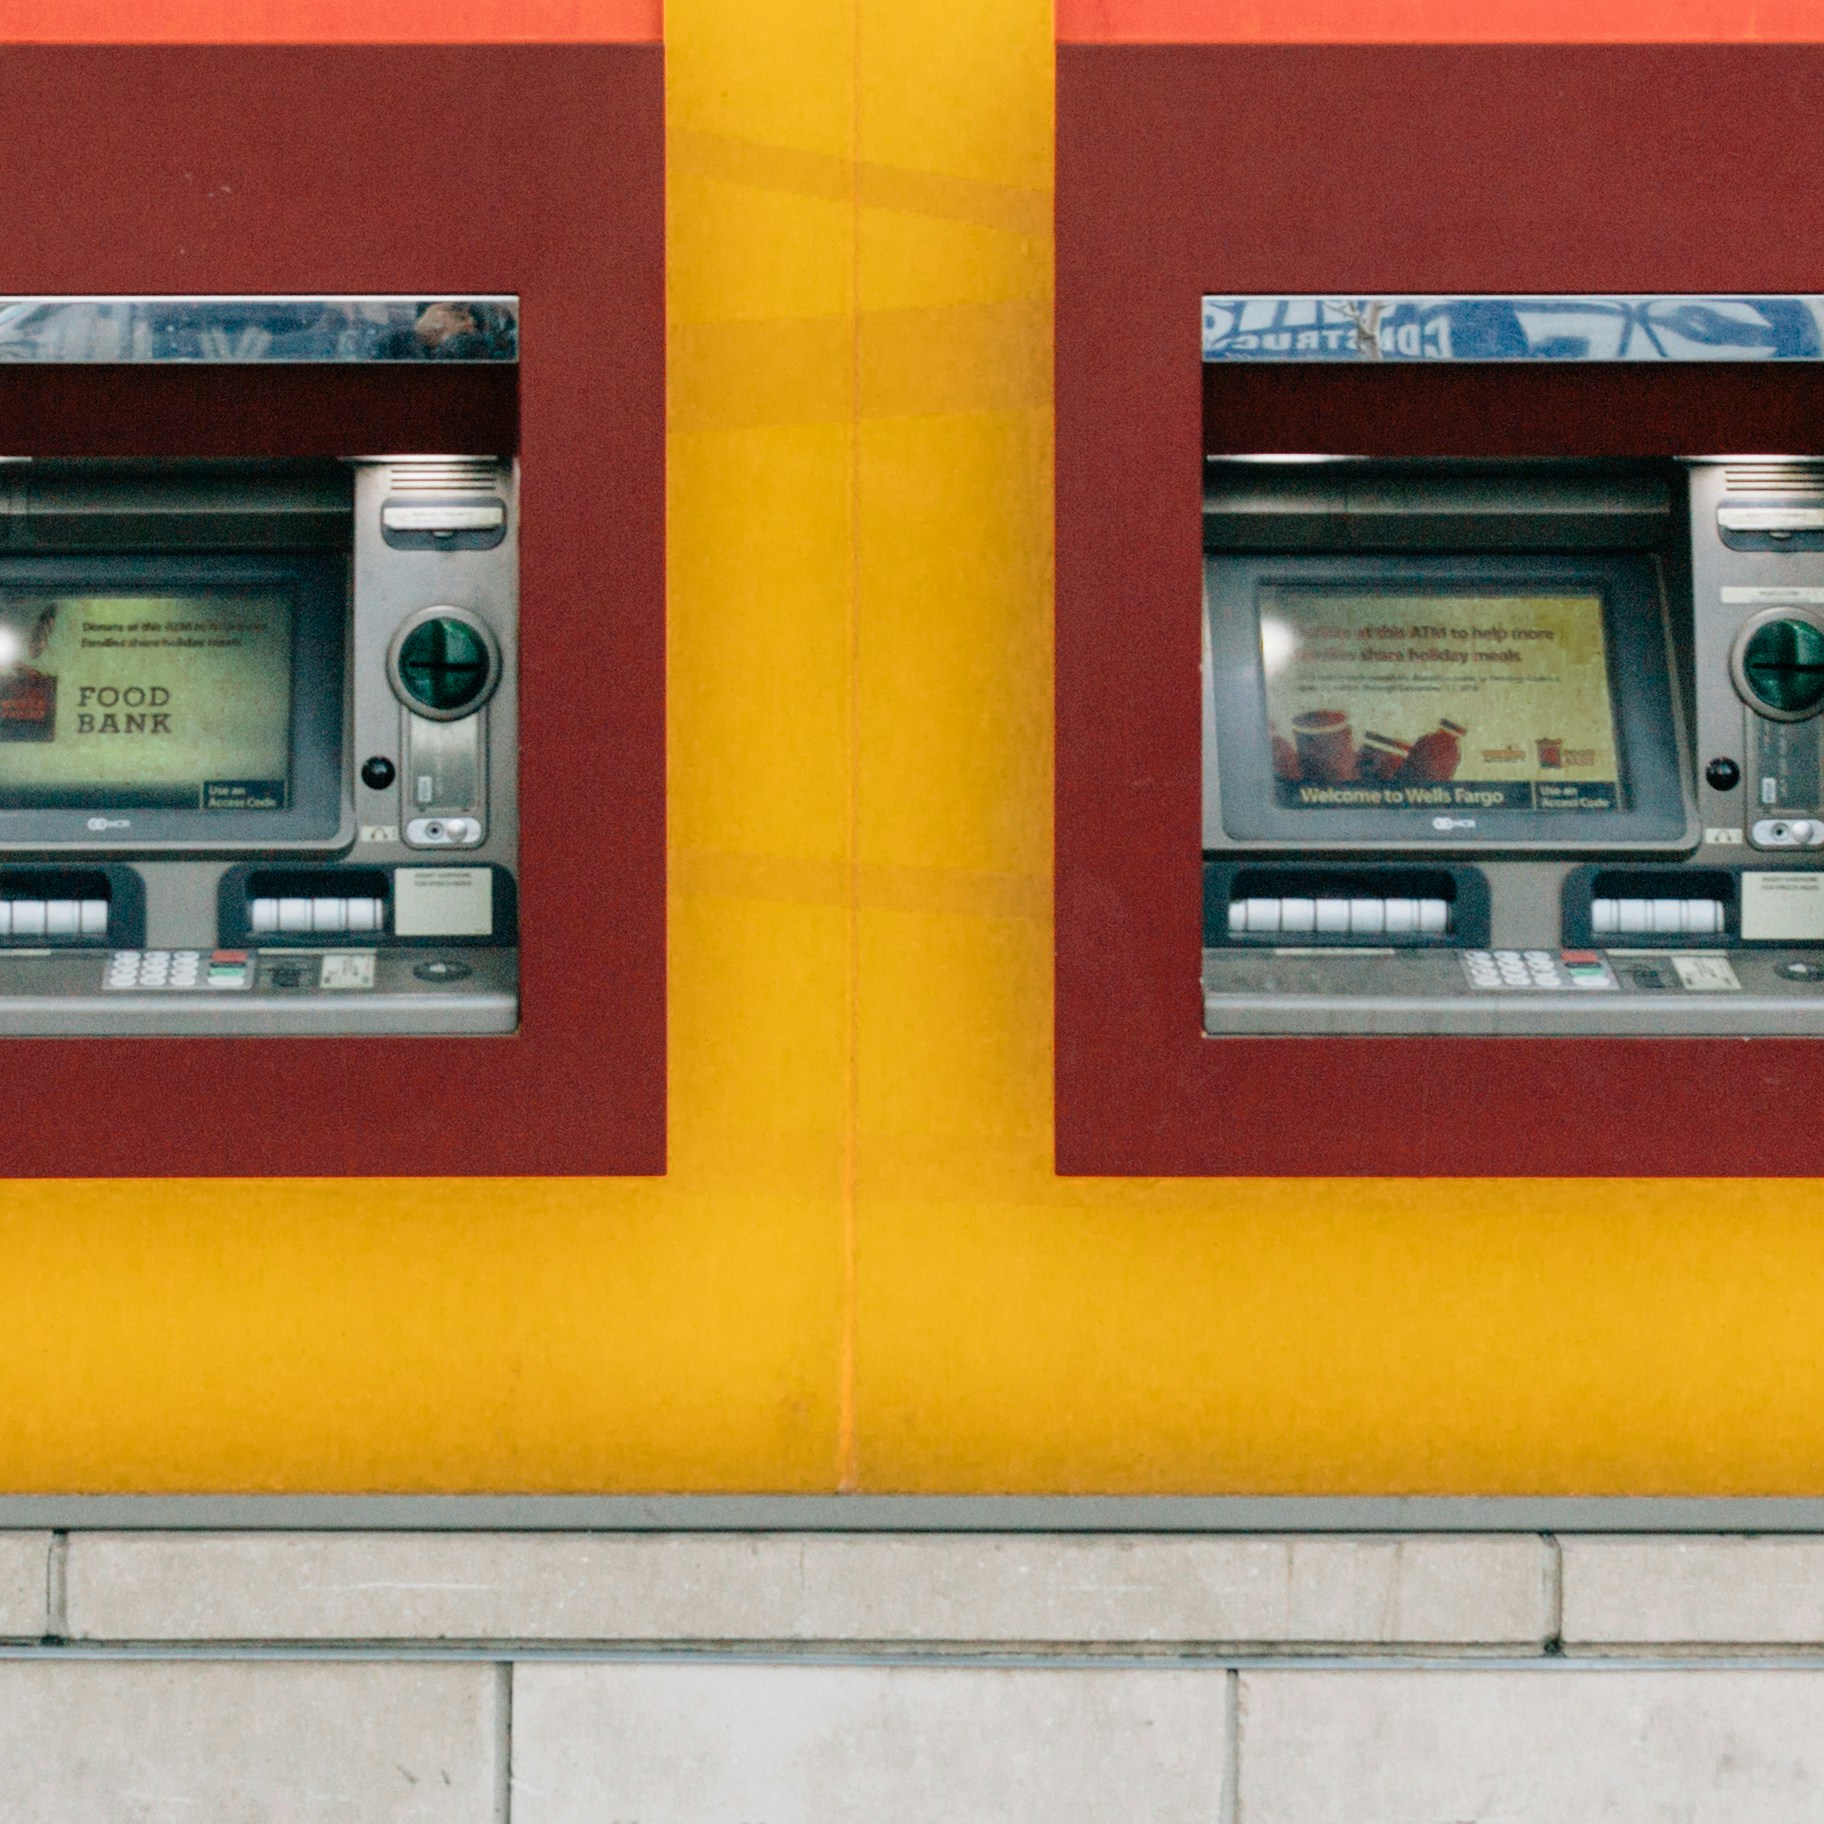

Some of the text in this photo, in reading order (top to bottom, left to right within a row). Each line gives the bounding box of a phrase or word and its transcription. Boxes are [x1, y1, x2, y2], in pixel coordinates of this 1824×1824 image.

[1377, 626, 1404, 640] this
[1409, 626, 1446, 640] ATM
[1451, 628, 1468, 640] to
[1472, 626, 1508, 643] help
[1512, 630, 1554, 641] more
[1360, 648, 1404, 662] share
[1408, 648, 1469, 664] holiday
[1473, 648, 1521, 662] meals
[78, 686, 171, 708] FOOD
[77, 713, 172, 734] BANK
[1301, 787, 1504, 807] Welcome to Wells Fargo
[1579, 797, 1610, 808] Code
